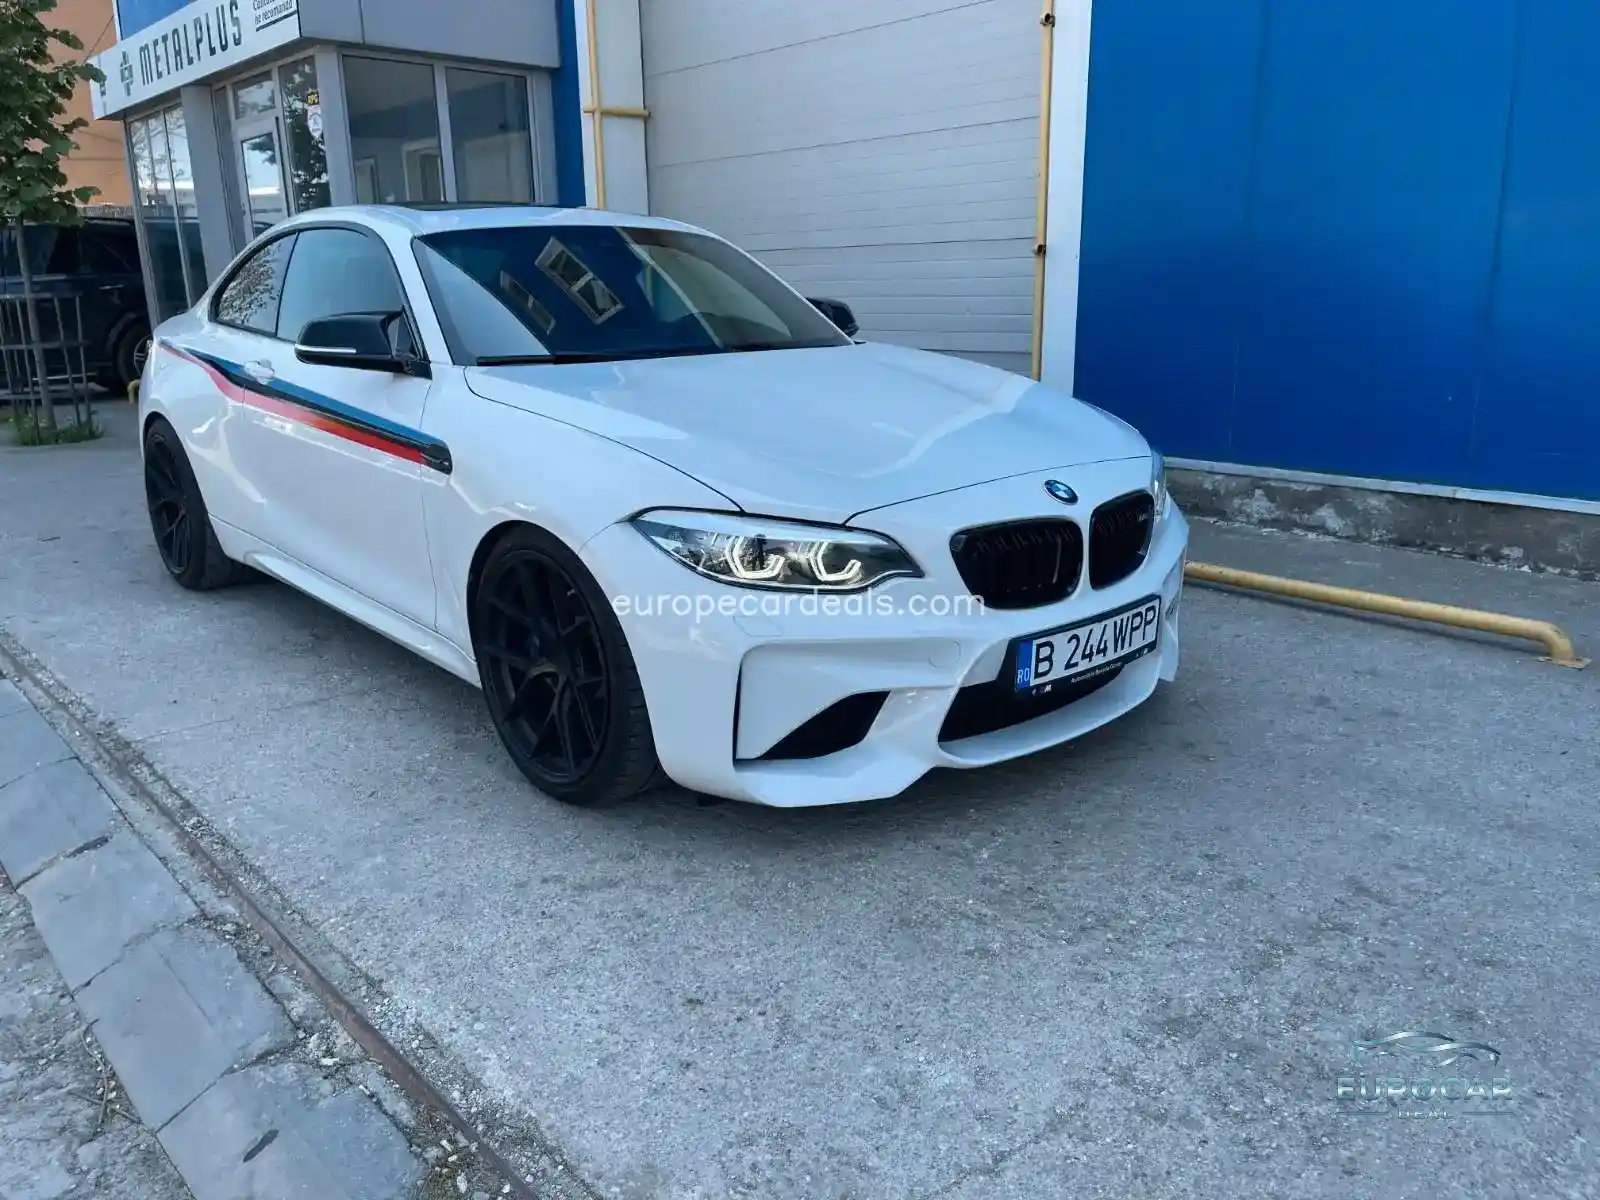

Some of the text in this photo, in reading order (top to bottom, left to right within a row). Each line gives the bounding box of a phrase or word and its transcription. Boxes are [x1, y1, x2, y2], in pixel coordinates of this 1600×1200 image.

[139, 0, 242, 86] METALPLUS
[1016, 667, 1030, 685] RO
[1033, 604, 1157, 680] B 244 WPP
